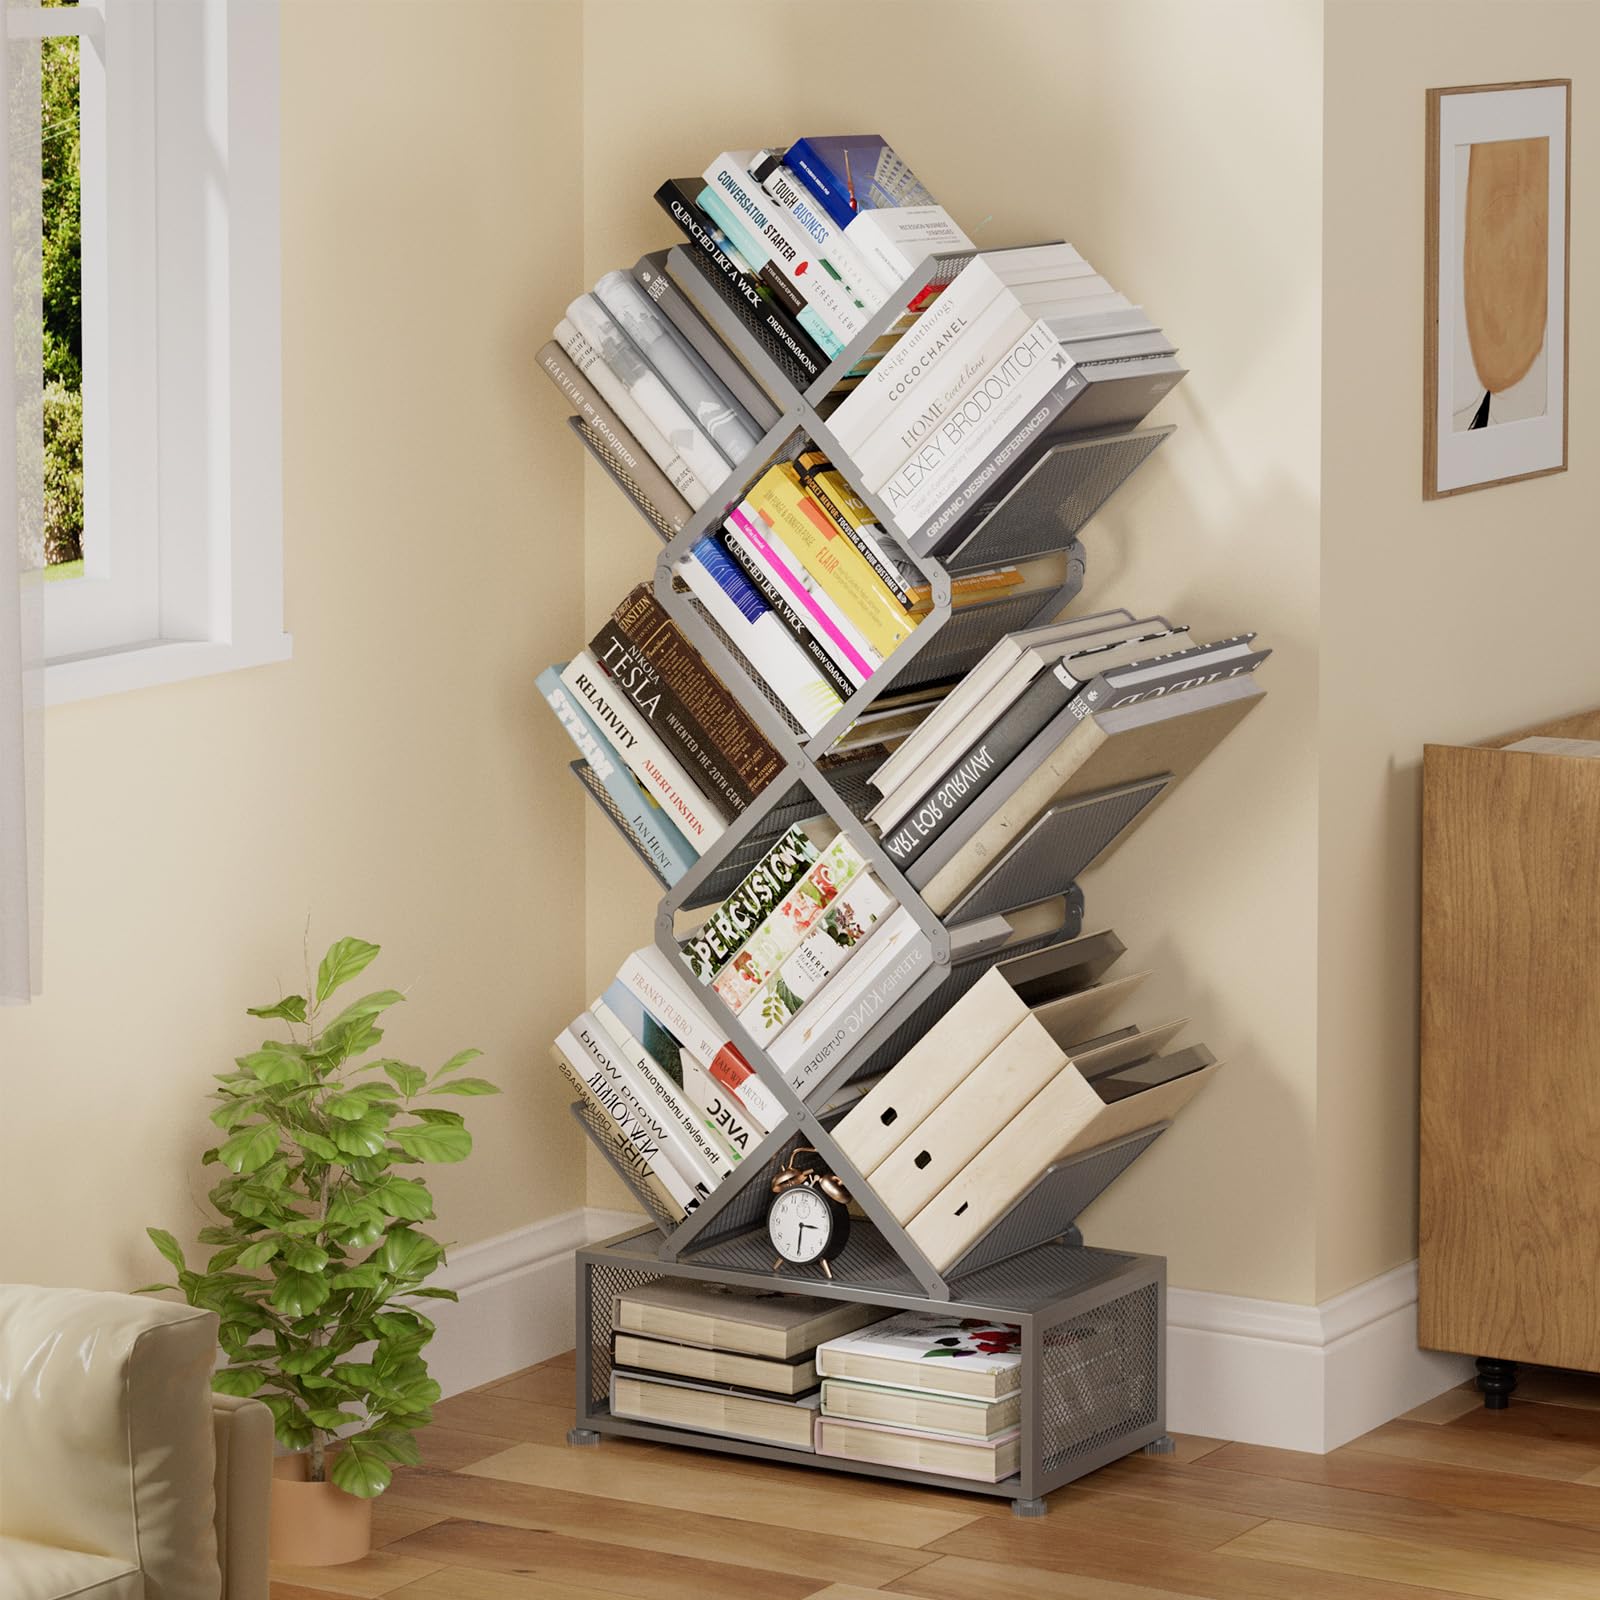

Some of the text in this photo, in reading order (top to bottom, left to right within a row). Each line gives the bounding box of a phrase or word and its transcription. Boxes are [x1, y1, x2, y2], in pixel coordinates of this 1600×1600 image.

[717, 170, 768, 230] CONVERSATION
[763, 224, 797, 262] STARTER
[772, 178, 799, 208] TOUGH
[793, 203, 830, 245] BUSINESS
[670, 200, 715, 251] QUENCHED
[711, 246, 734, 274] LIKE
[728, 269, 739, 282] A
[736, 278, 763, 309] WICK
[776, 276, 794, 299] START-UP
[790, 293, 803, 307] PHASE
[811, 279, 840, 315] TERESA
[837, 312, 858, 337] LEWI
[766, 314, 819, 376] DREW SIMMONS
[877, 347, 910, 385] design
[908, 295, 956, 353] anthology
[886, 331, 1047, 512] ALEXEY BRODOVITCH
[900, 398, 948, 449] HOME
[926, 495, 967, 540] GRAPHIC
[962, 462, 1000, 504] DESIGN
[993, 406, 1052, 467] REFERENCED
[804, 474, 823, 500] POCKET
[820, 494, 840, 520] MENTOR:
[838, 516, 861, 545] FOCUSING
[857, 541, 867, 553] ON
[863, 548, 879, 567] YOUR
[874, 562, 900, 594] CUSTOMER
[815, 546, 841, 575] FLAIR
[724, 533, 806, 636] QUENCHED LIKE A WICK
[601, 635, 664, 721] TESLA
[628, 644, 661, 686] NIKOLA
[808, 639, 855, 698] DREW SIMMONS
[548, 688, 616, 782] STEAM
[575, 673, 639, 751] RELATIVITY
[665, 711, 699, 754] INVENTED
[694, 748, 712, 770] THE
[706, 764, 729, 790] 20TH
[641, 758, 673, 797] ALBERT
[668, 790, 705, 837] EINSTEIN
[632, 814, 673, 870] IAN HUNT
[633, 973, 667, 1008] FRANKY
[700, 1039, 732, 1080] WILLIAM
[791, 1195, 797, 1204] 11
